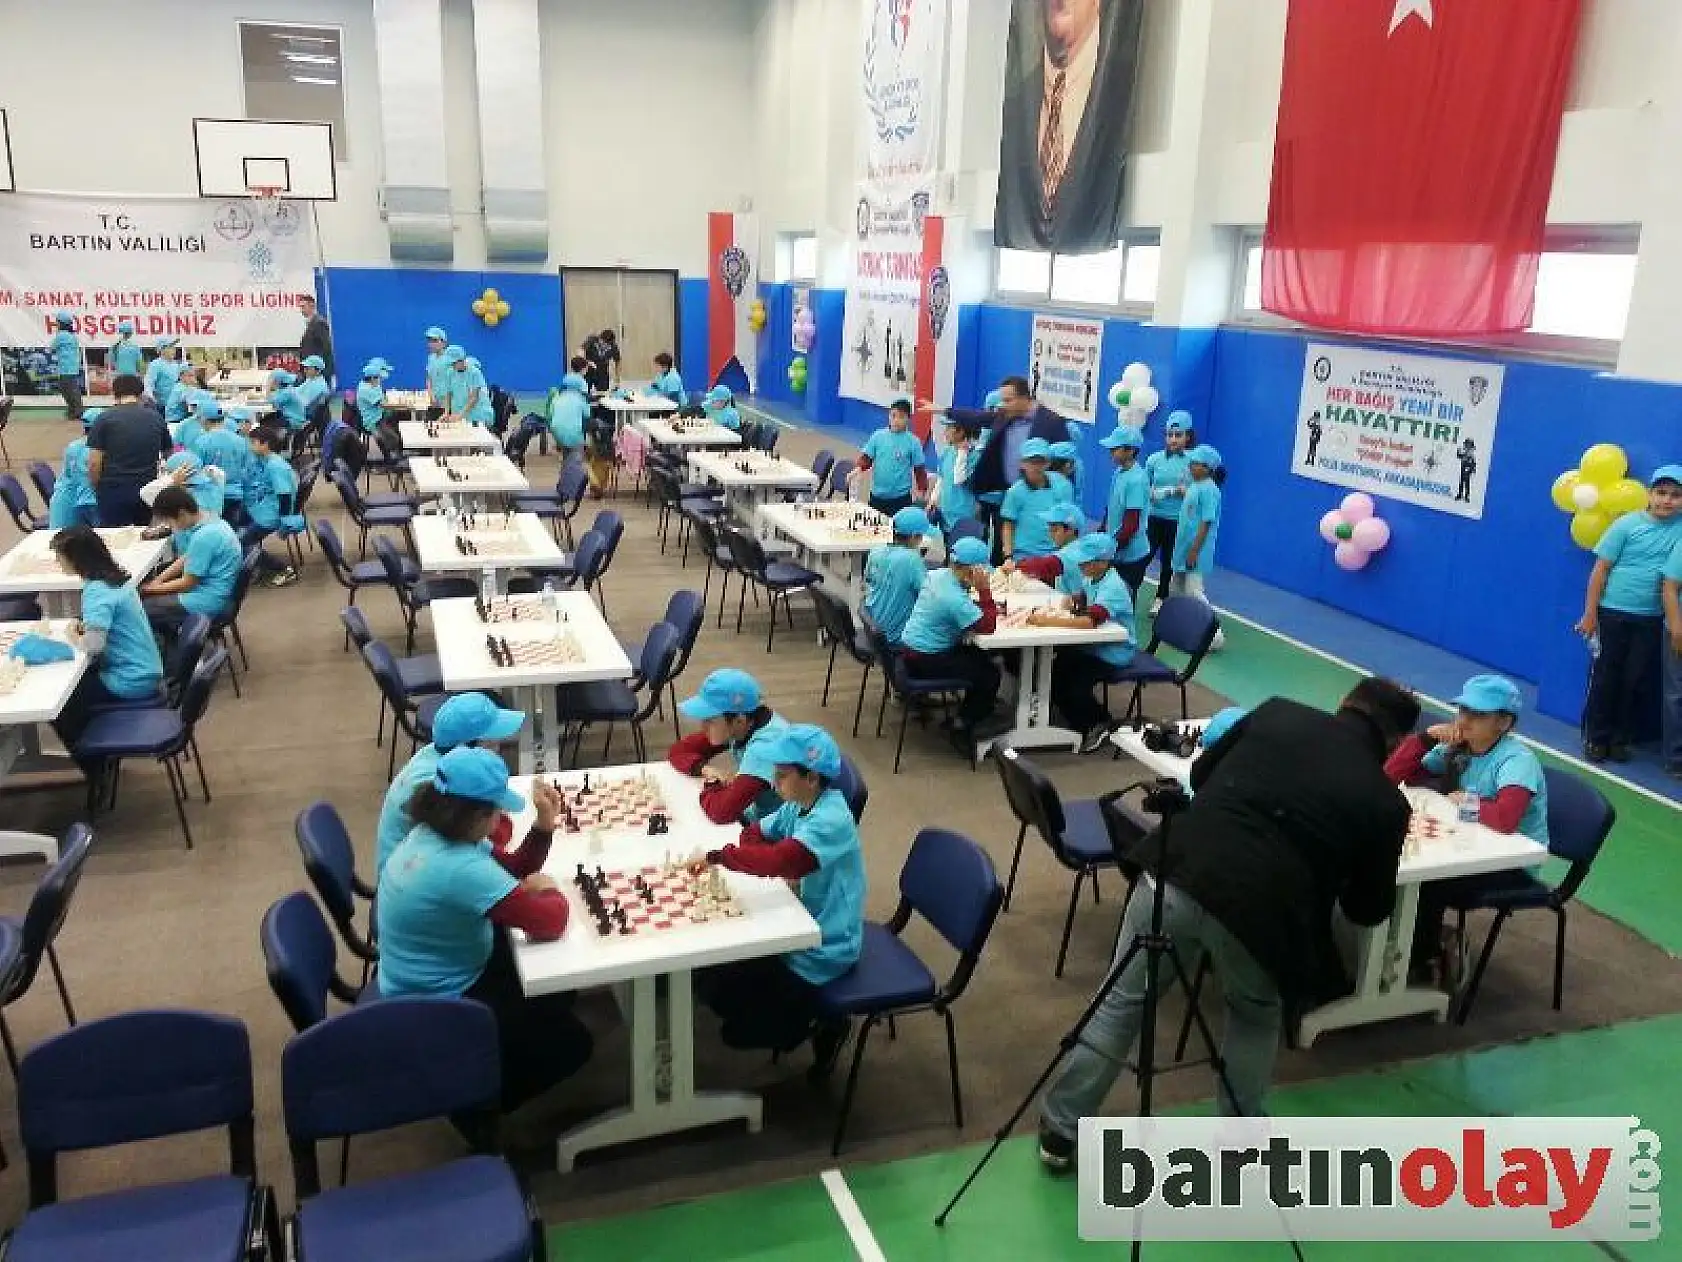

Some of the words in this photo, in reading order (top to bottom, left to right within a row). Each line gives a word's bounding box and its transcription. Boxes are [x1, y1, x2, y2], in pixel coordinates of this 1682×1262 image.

[97, 213, 136, 231] T.C.
[30, 233, 111, 251] BARTIN
[118, 233, 206, 253] VALİLİĞİ
[24, 291, 88, 310] SANAT,
[95, 289, 165, 308] KÜLTÜR
[172, 292, 193, 308] VE
[200, 292, 244, 308] SPOR
[1326, 386, 1352, 403] HER
[1355, 389, 1395, 414] BAĞIŞ
[1400, 396, 1434, 417] YENİ
[1437, 400, 1464, 421] BİR
[1326, 404, 1460, 444] HAYATTIR!
